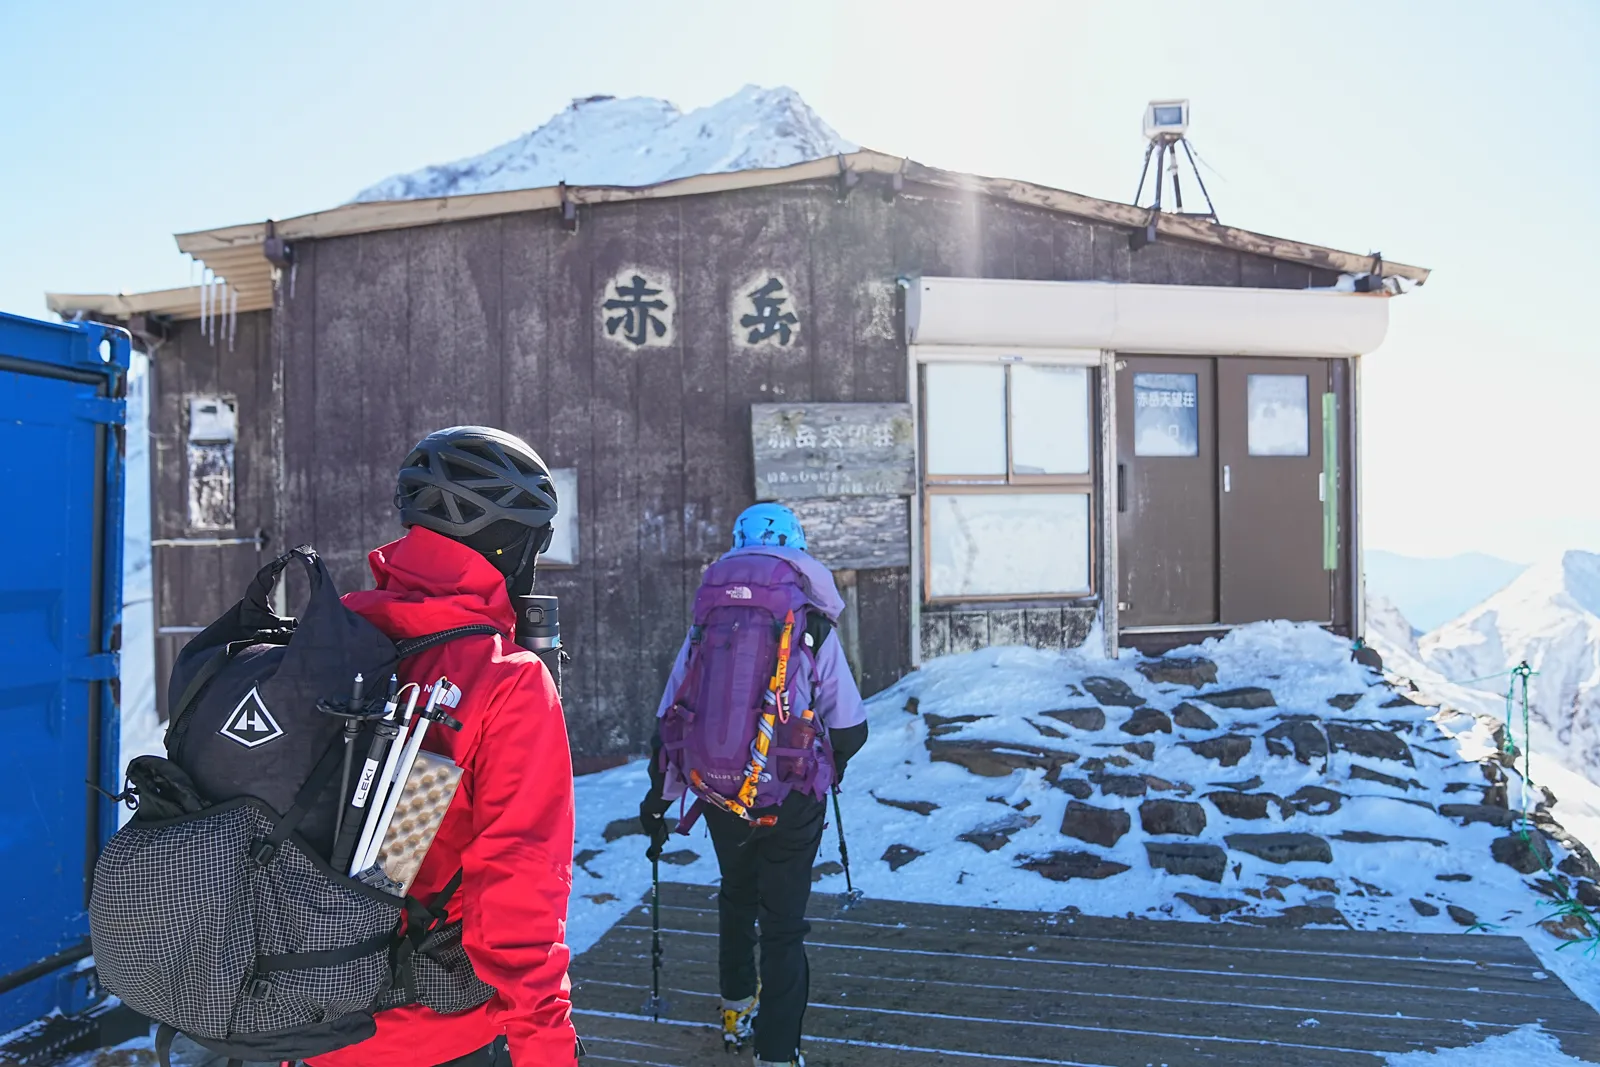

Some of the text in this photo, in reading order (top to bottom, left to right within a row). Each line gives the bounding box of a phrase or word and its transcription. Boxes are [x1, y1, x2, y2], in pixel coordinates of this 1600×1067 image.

[1136, 391, 1195, 408] 赤岳天望荘
[357, 767, 374, 801] LEKI
